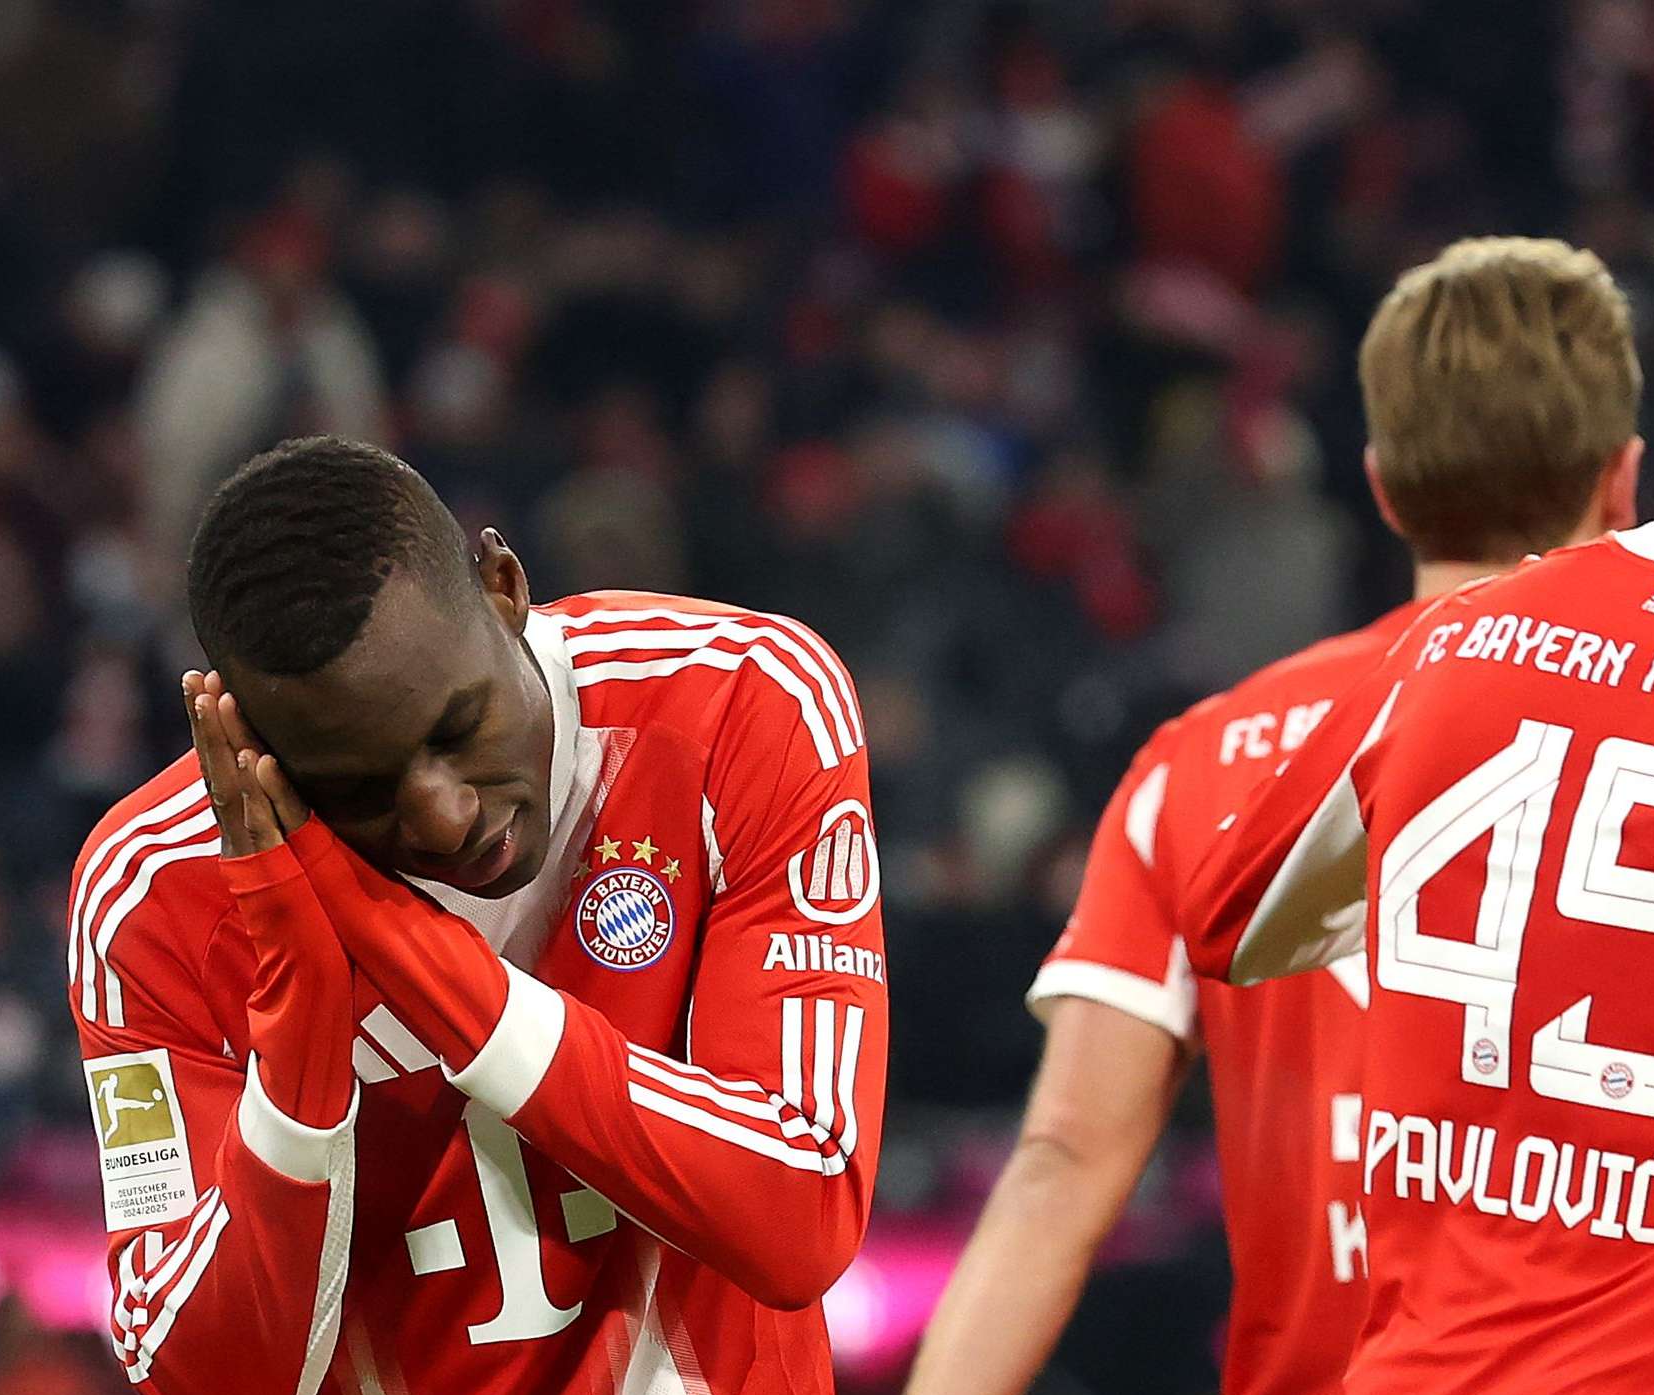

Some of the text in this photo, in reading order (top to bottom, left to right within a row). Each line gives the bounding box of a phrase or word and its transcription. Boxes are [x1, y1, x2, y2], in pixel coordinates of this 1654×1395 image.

[1415, 621, 1463, 671] FC
[1455, 614, 1636, 687] BAYERN
[1219, 711, 1278, 766] FC
[582, 875, 664, 921] FC BAYERN
[588, 921, 669, 964] MÜNCHEN
[105, 1148, 180, 1170] BUNDESLIGA
[118, 1182, 168, 1198] DEUTSCHER
[123, 1204, 168, 1218] 2024/2025
